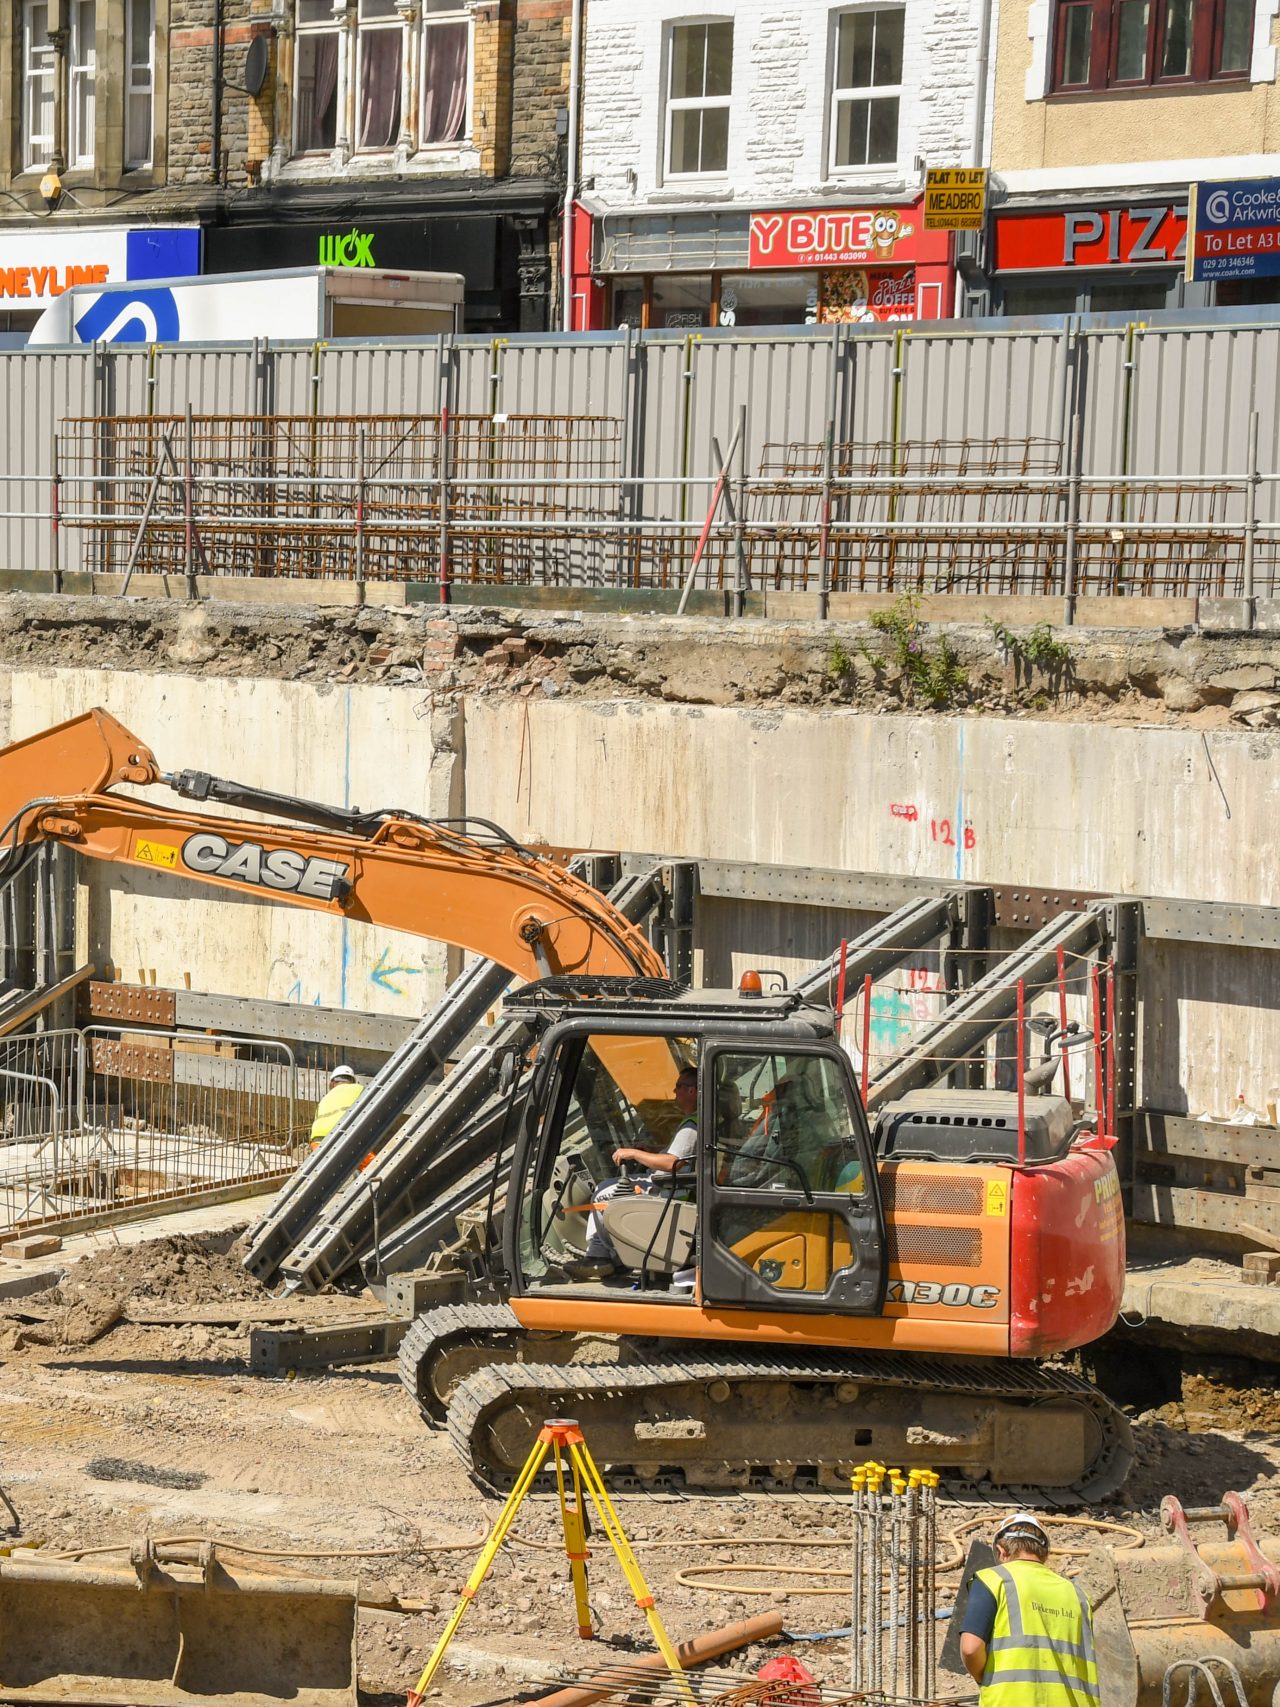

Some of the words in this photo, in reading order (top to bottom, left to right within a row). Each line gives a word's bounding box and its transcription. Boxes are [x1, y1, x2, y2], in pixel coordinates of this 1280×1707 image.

[928, 171, 951, 184] FLAT
[954, 171, 966, 184] TO
[969, 171, 984, 183] LET
[929, 192, 981, 210] MEADBRO
[751, 217, 783, 254] Y
[787, 213, 873, 251] BITE
[1204, 234, 1222, 251] To
[1228, 234, 1253, 249] Let
[1257, 233, 1273, 248] A3
[319, 232, 376, 267] WOK
[814, 253, 838, 262] 01443
[839, 252, 867, 261] 403090
[1203, 259, 1216, 269] 029
[1218, 258, 1227, 268] 20
[1228, 257, 1255, 268] 346346
[883, 293, 914, 306] OFFE
[931, 819, 955, 846] 12
[964, 828, 976, 849] B
[182, 832, 350, 901] CASE
[910, 966, 932, 991] 12
